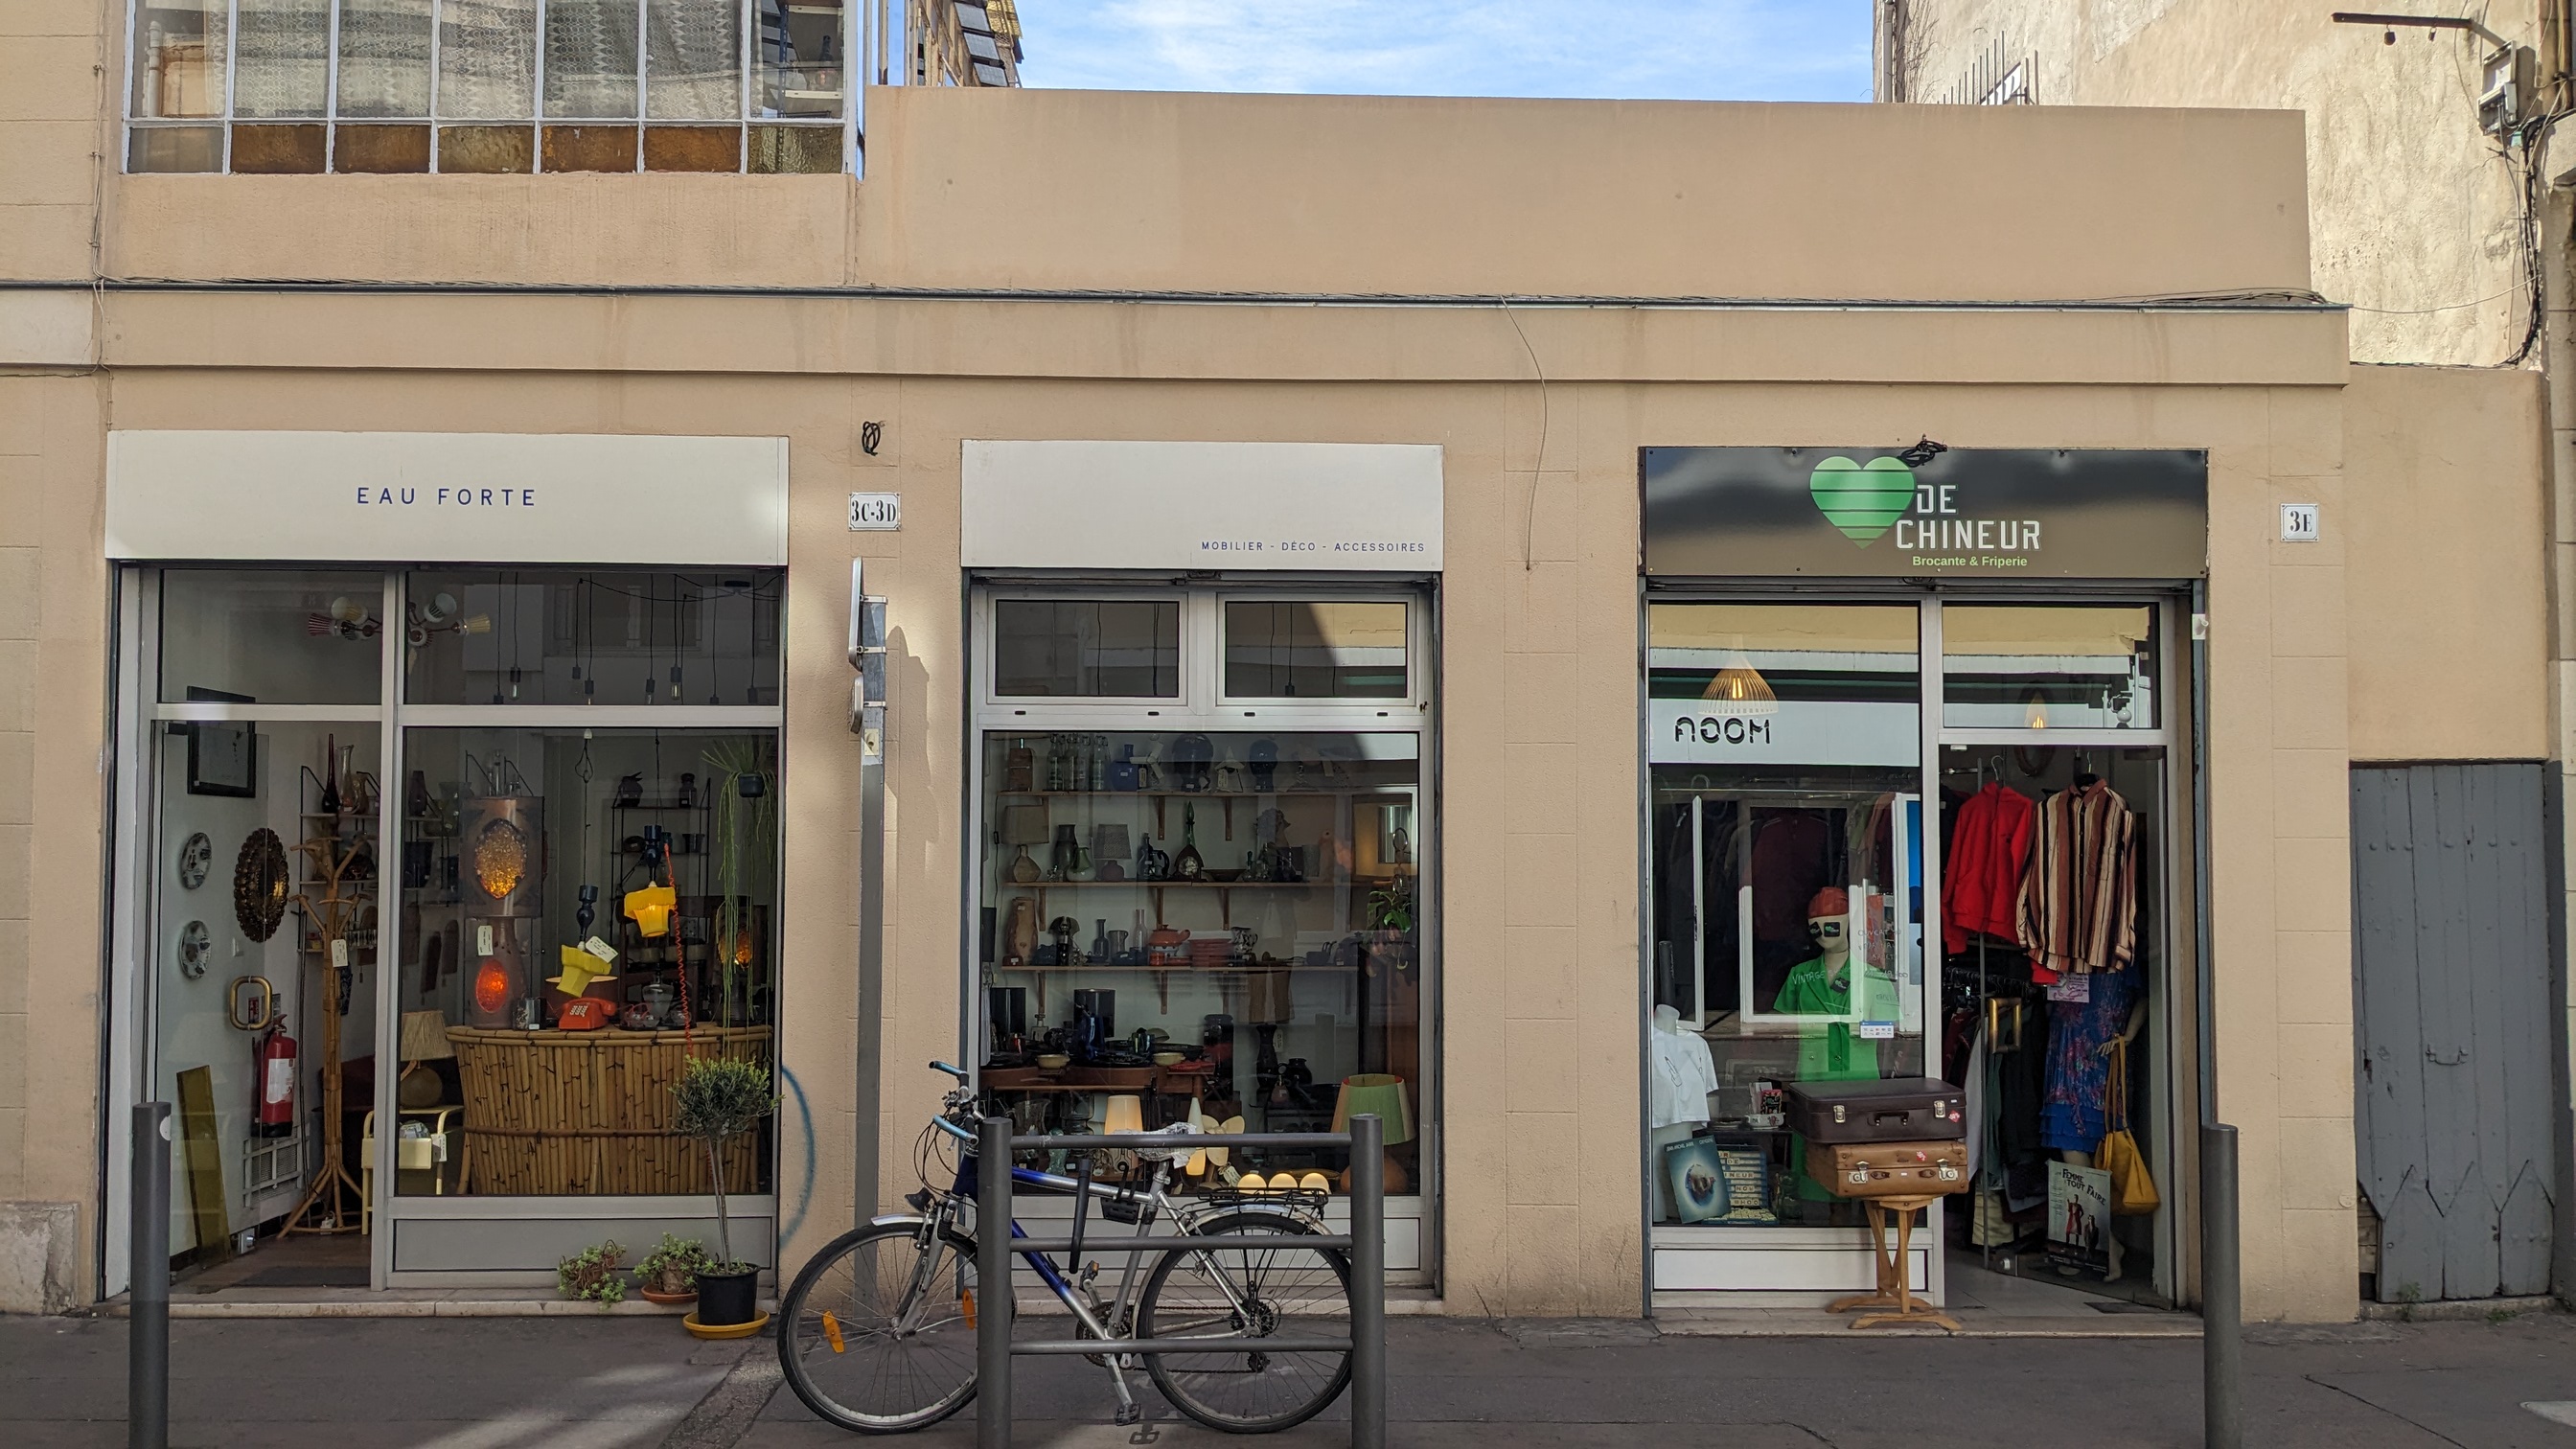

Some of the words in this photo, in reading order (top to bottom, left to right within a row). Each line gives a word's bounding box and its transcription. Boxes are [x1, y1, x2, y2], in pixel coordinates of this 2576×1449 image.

[356, 486, 415, 505] EAU
[437, 487, 536, 506] FORTE
[1917, 484, 1957, 514] DE
[851, 499, 897, 522] 3C-3D
[2289, 510, 2312, 533] 3E
[1897, 519, 2041, 550] CHINEUR
[1201, 540, 1263, 552] MOBILIER
[1281, 540, 1316, 552] DÉCO
[1334, 541, 1425, 552] ACCESSOIRES
[1912, 555, 1966, 566] Brocante
[1968, 556, 1979, 566] &
[1981, 555, 2028, 568] Friperie
[1792, 969, 1827, 986] VINTAGE
[2062, 1168, 2084, 1184] FEMME
[2067, 1179, 2086, 1191] TOUT
[2086, 1184, 2107, 1206] FAIRE
